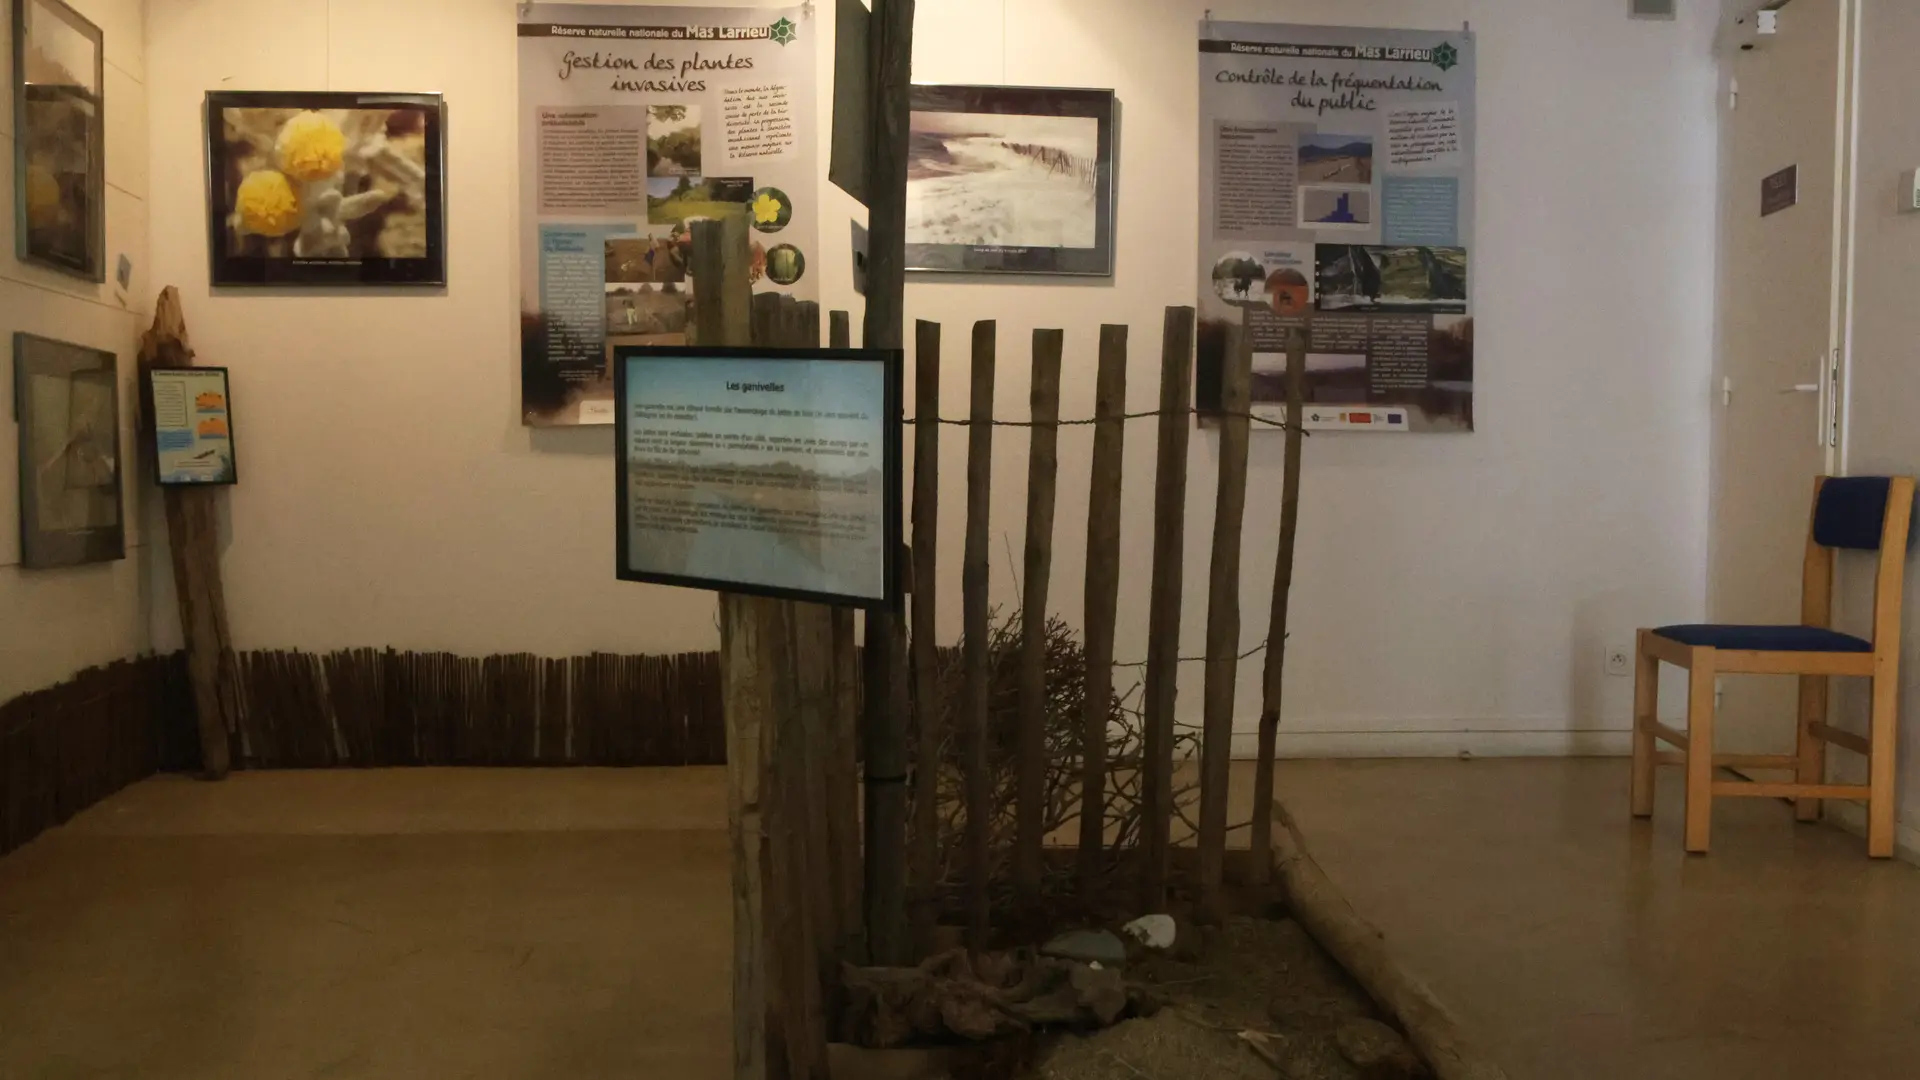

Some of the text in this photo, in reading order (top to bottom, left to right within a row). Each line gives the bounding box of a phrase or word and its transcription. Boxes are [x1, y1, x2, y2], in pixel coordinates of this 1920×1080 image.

[551, 24, 768, 39] Réserve naturelle nationale du Mas Larrieu
[1230, 42, 1430, 60] Réserve naturelle nationale du Mas Larrieu
[559, 50, 754, 80] Gestion des plantes
[609, 74, 706, 92] invasives
[1215, 67, 1443, 96] Contrôle de la fréquentation
[1291, 90, 1377, 117] du public
[726, 381, 785, 393] Les ganivelles
